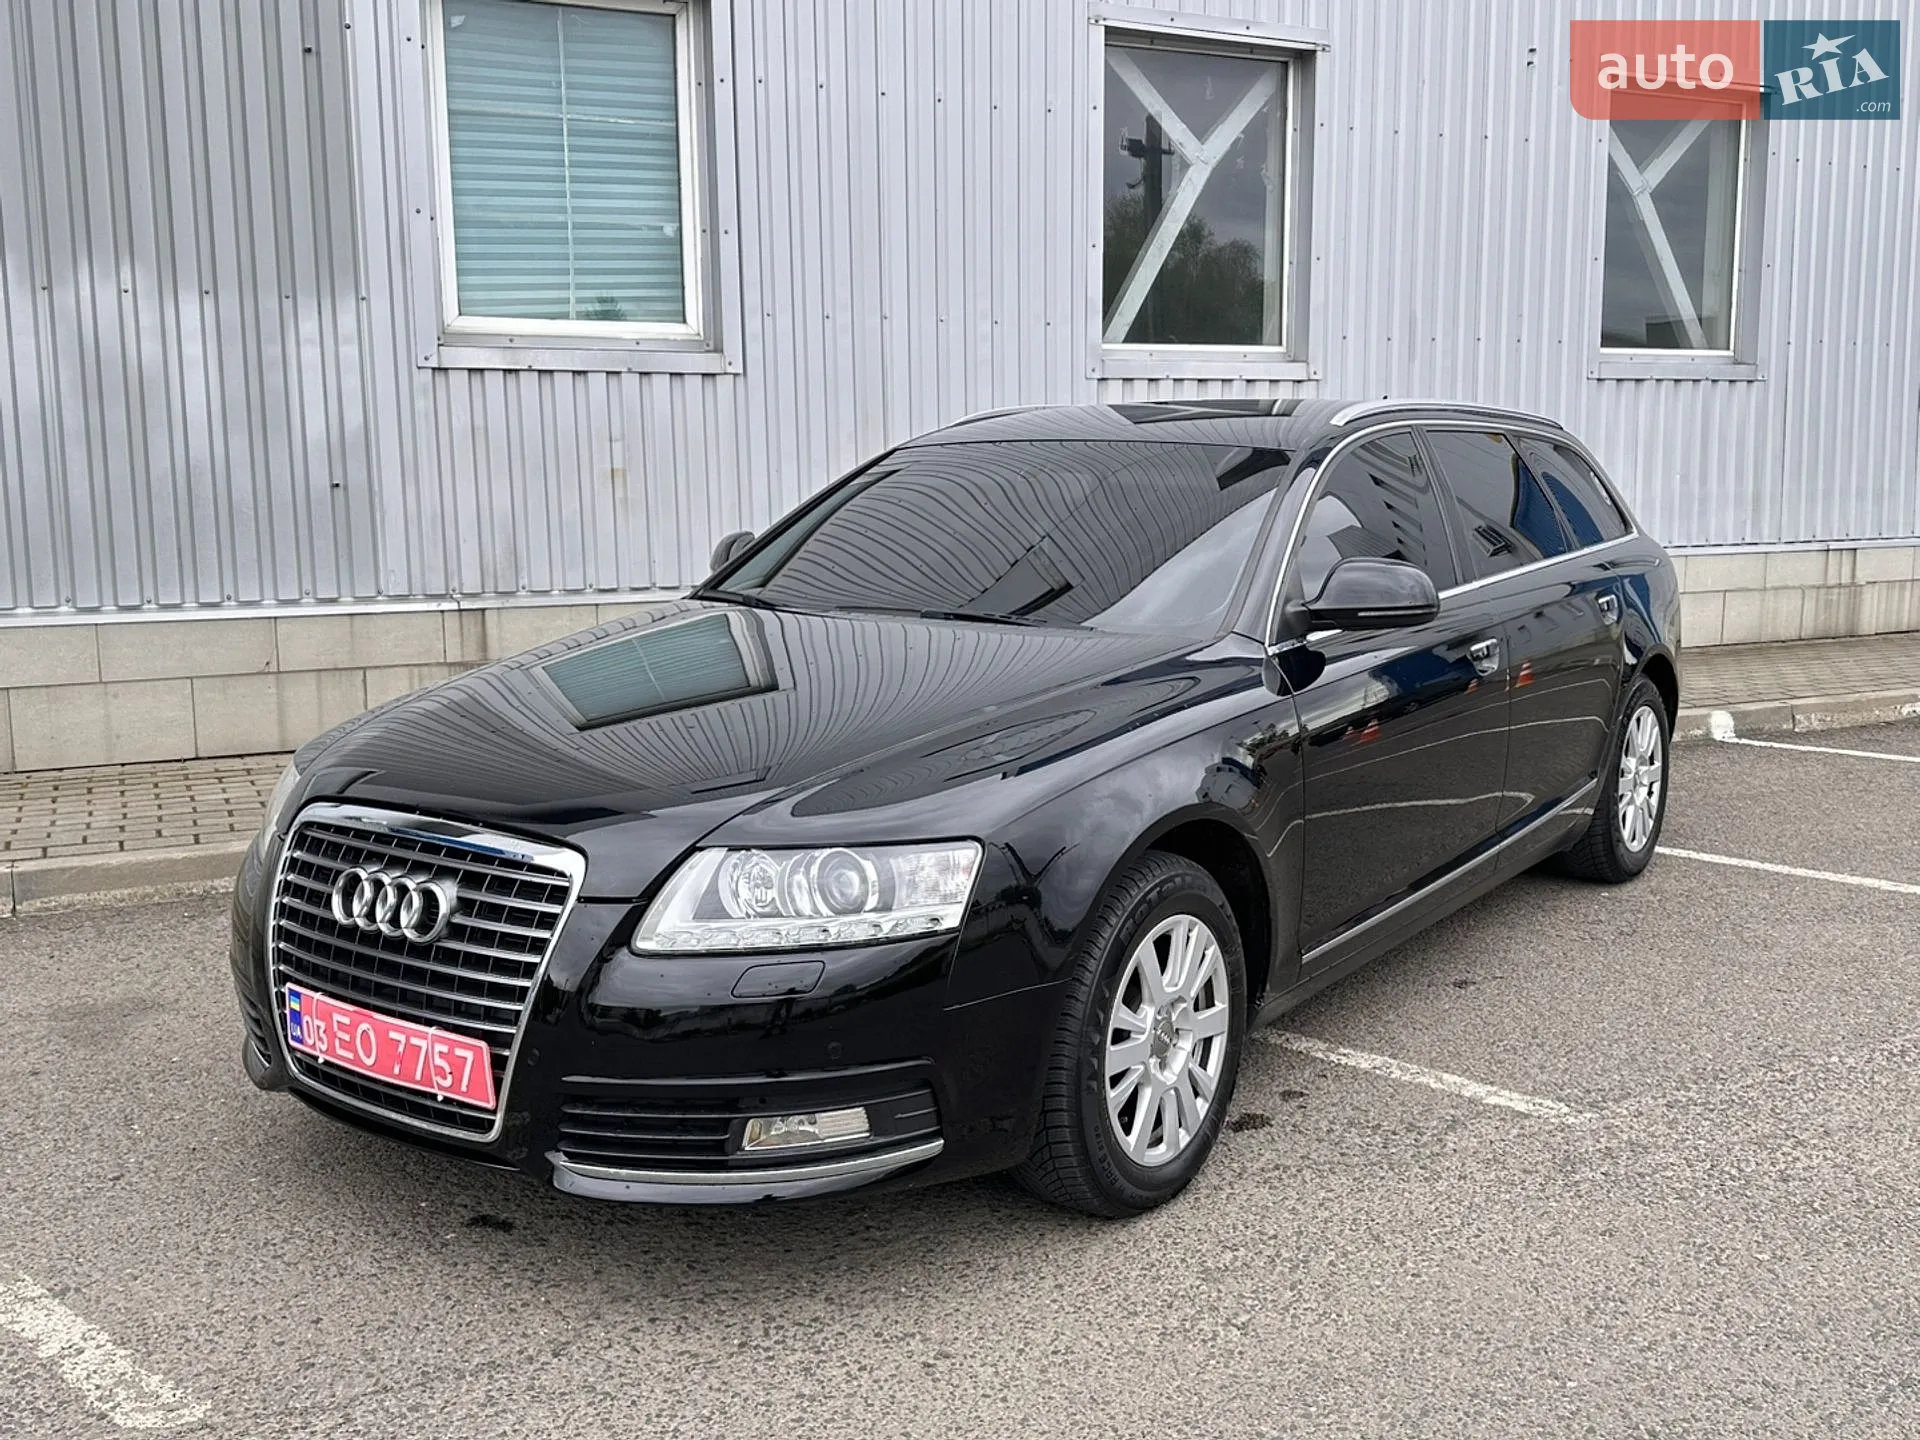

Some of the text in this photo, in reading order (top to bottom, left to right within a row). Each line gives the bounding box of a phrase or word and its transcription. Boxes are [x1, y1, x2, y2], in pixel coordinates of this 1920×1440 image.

[291, 1022, 302, 1039] UA
[303, 1012, 474, 1092] 03 EO 7757
